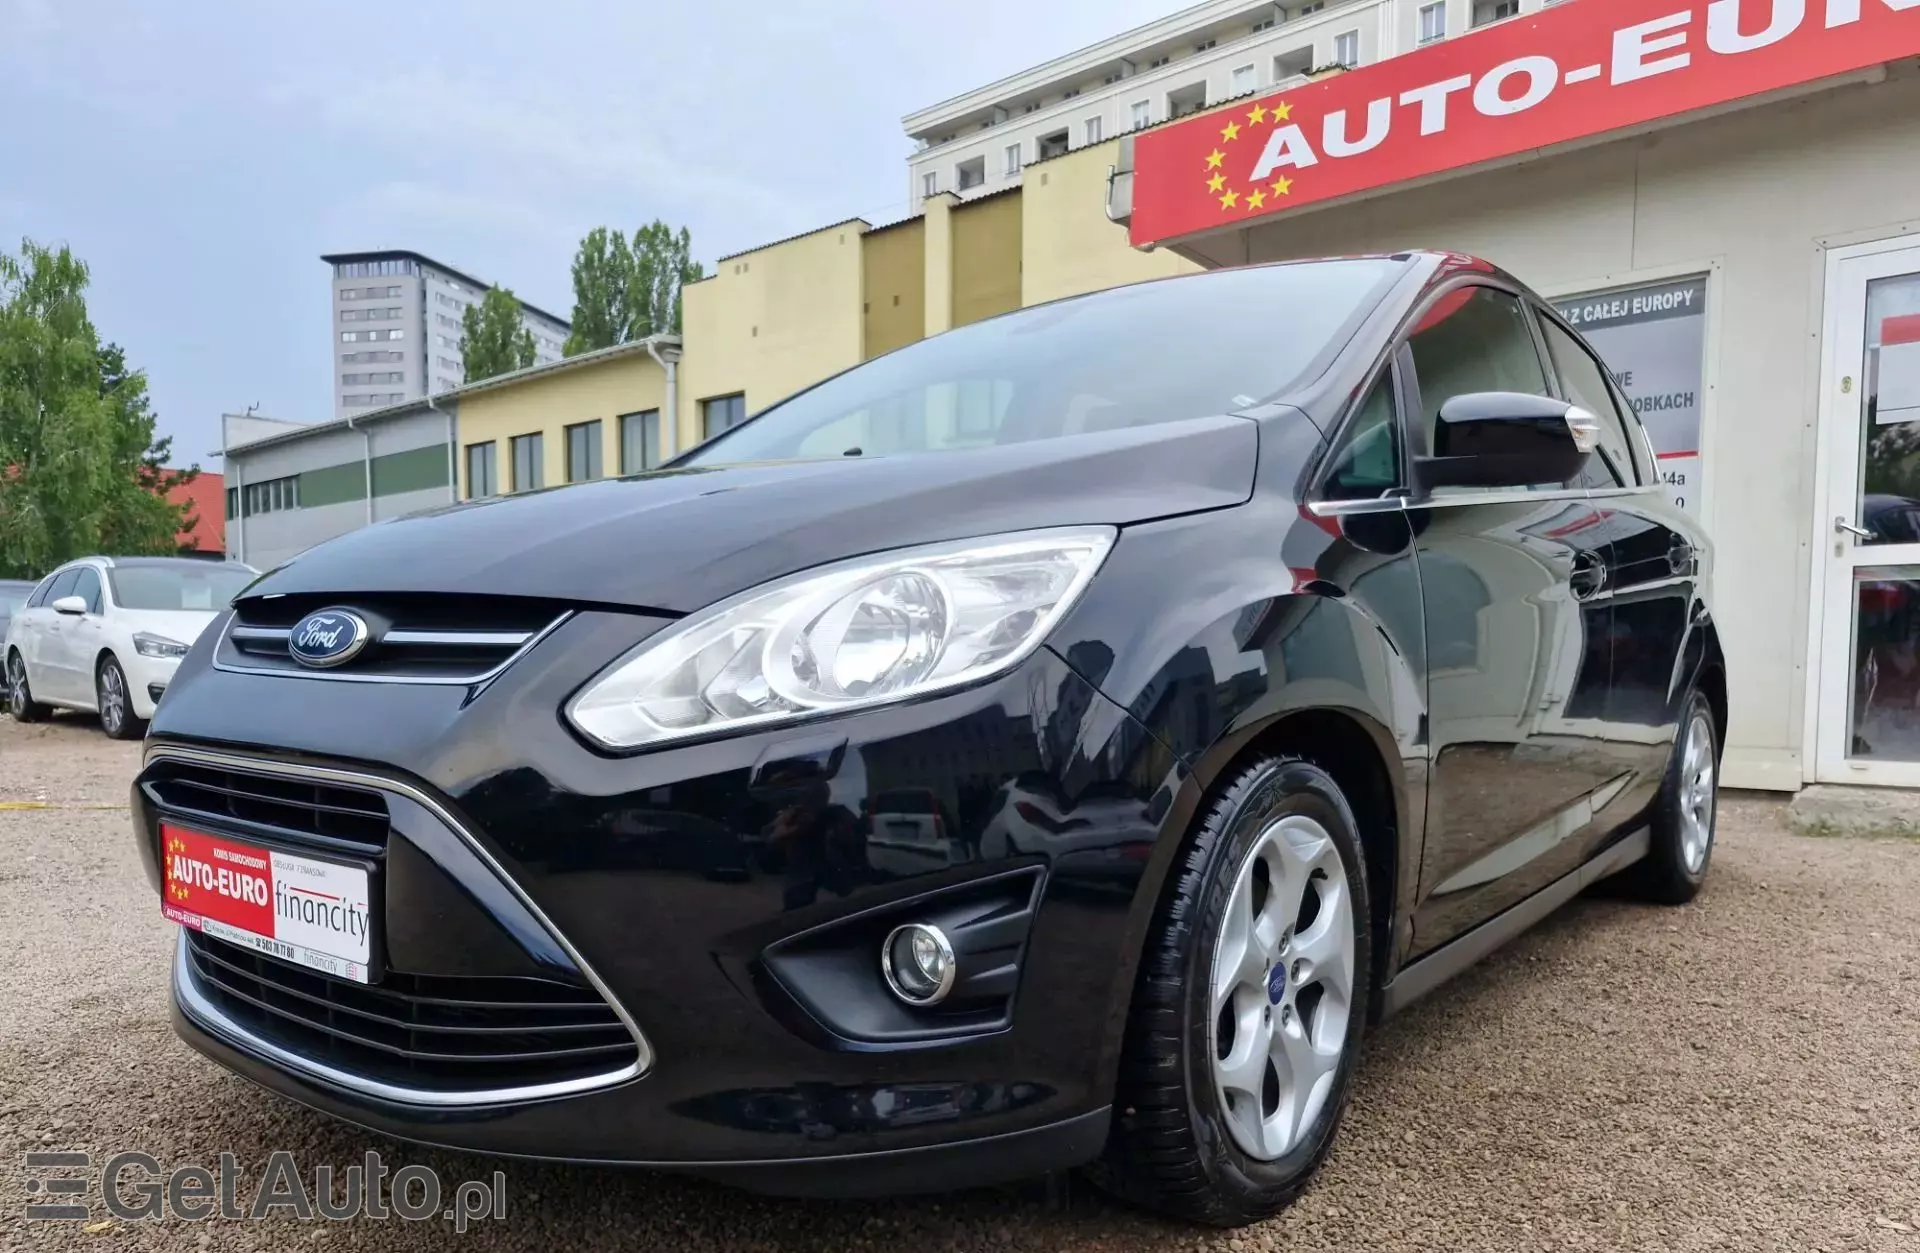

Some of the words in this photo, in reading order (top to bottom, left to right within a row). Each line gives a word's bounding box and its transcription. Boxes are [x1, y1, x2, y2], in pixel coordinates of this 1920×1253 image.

[1583, 299, 1629, 322] CAŁEJ
[1632, 288, 1694, 315] EUROPY
[298, 617, 343, 648] Ford
[172, 854, 268, 907] AUTO-EURO
[166, 907, 201, 927] AUTO-EURO
[275, 880, 370, 947] financity
[287, 947, 295, 959] 80
[304, 948, 338, 974] financity
